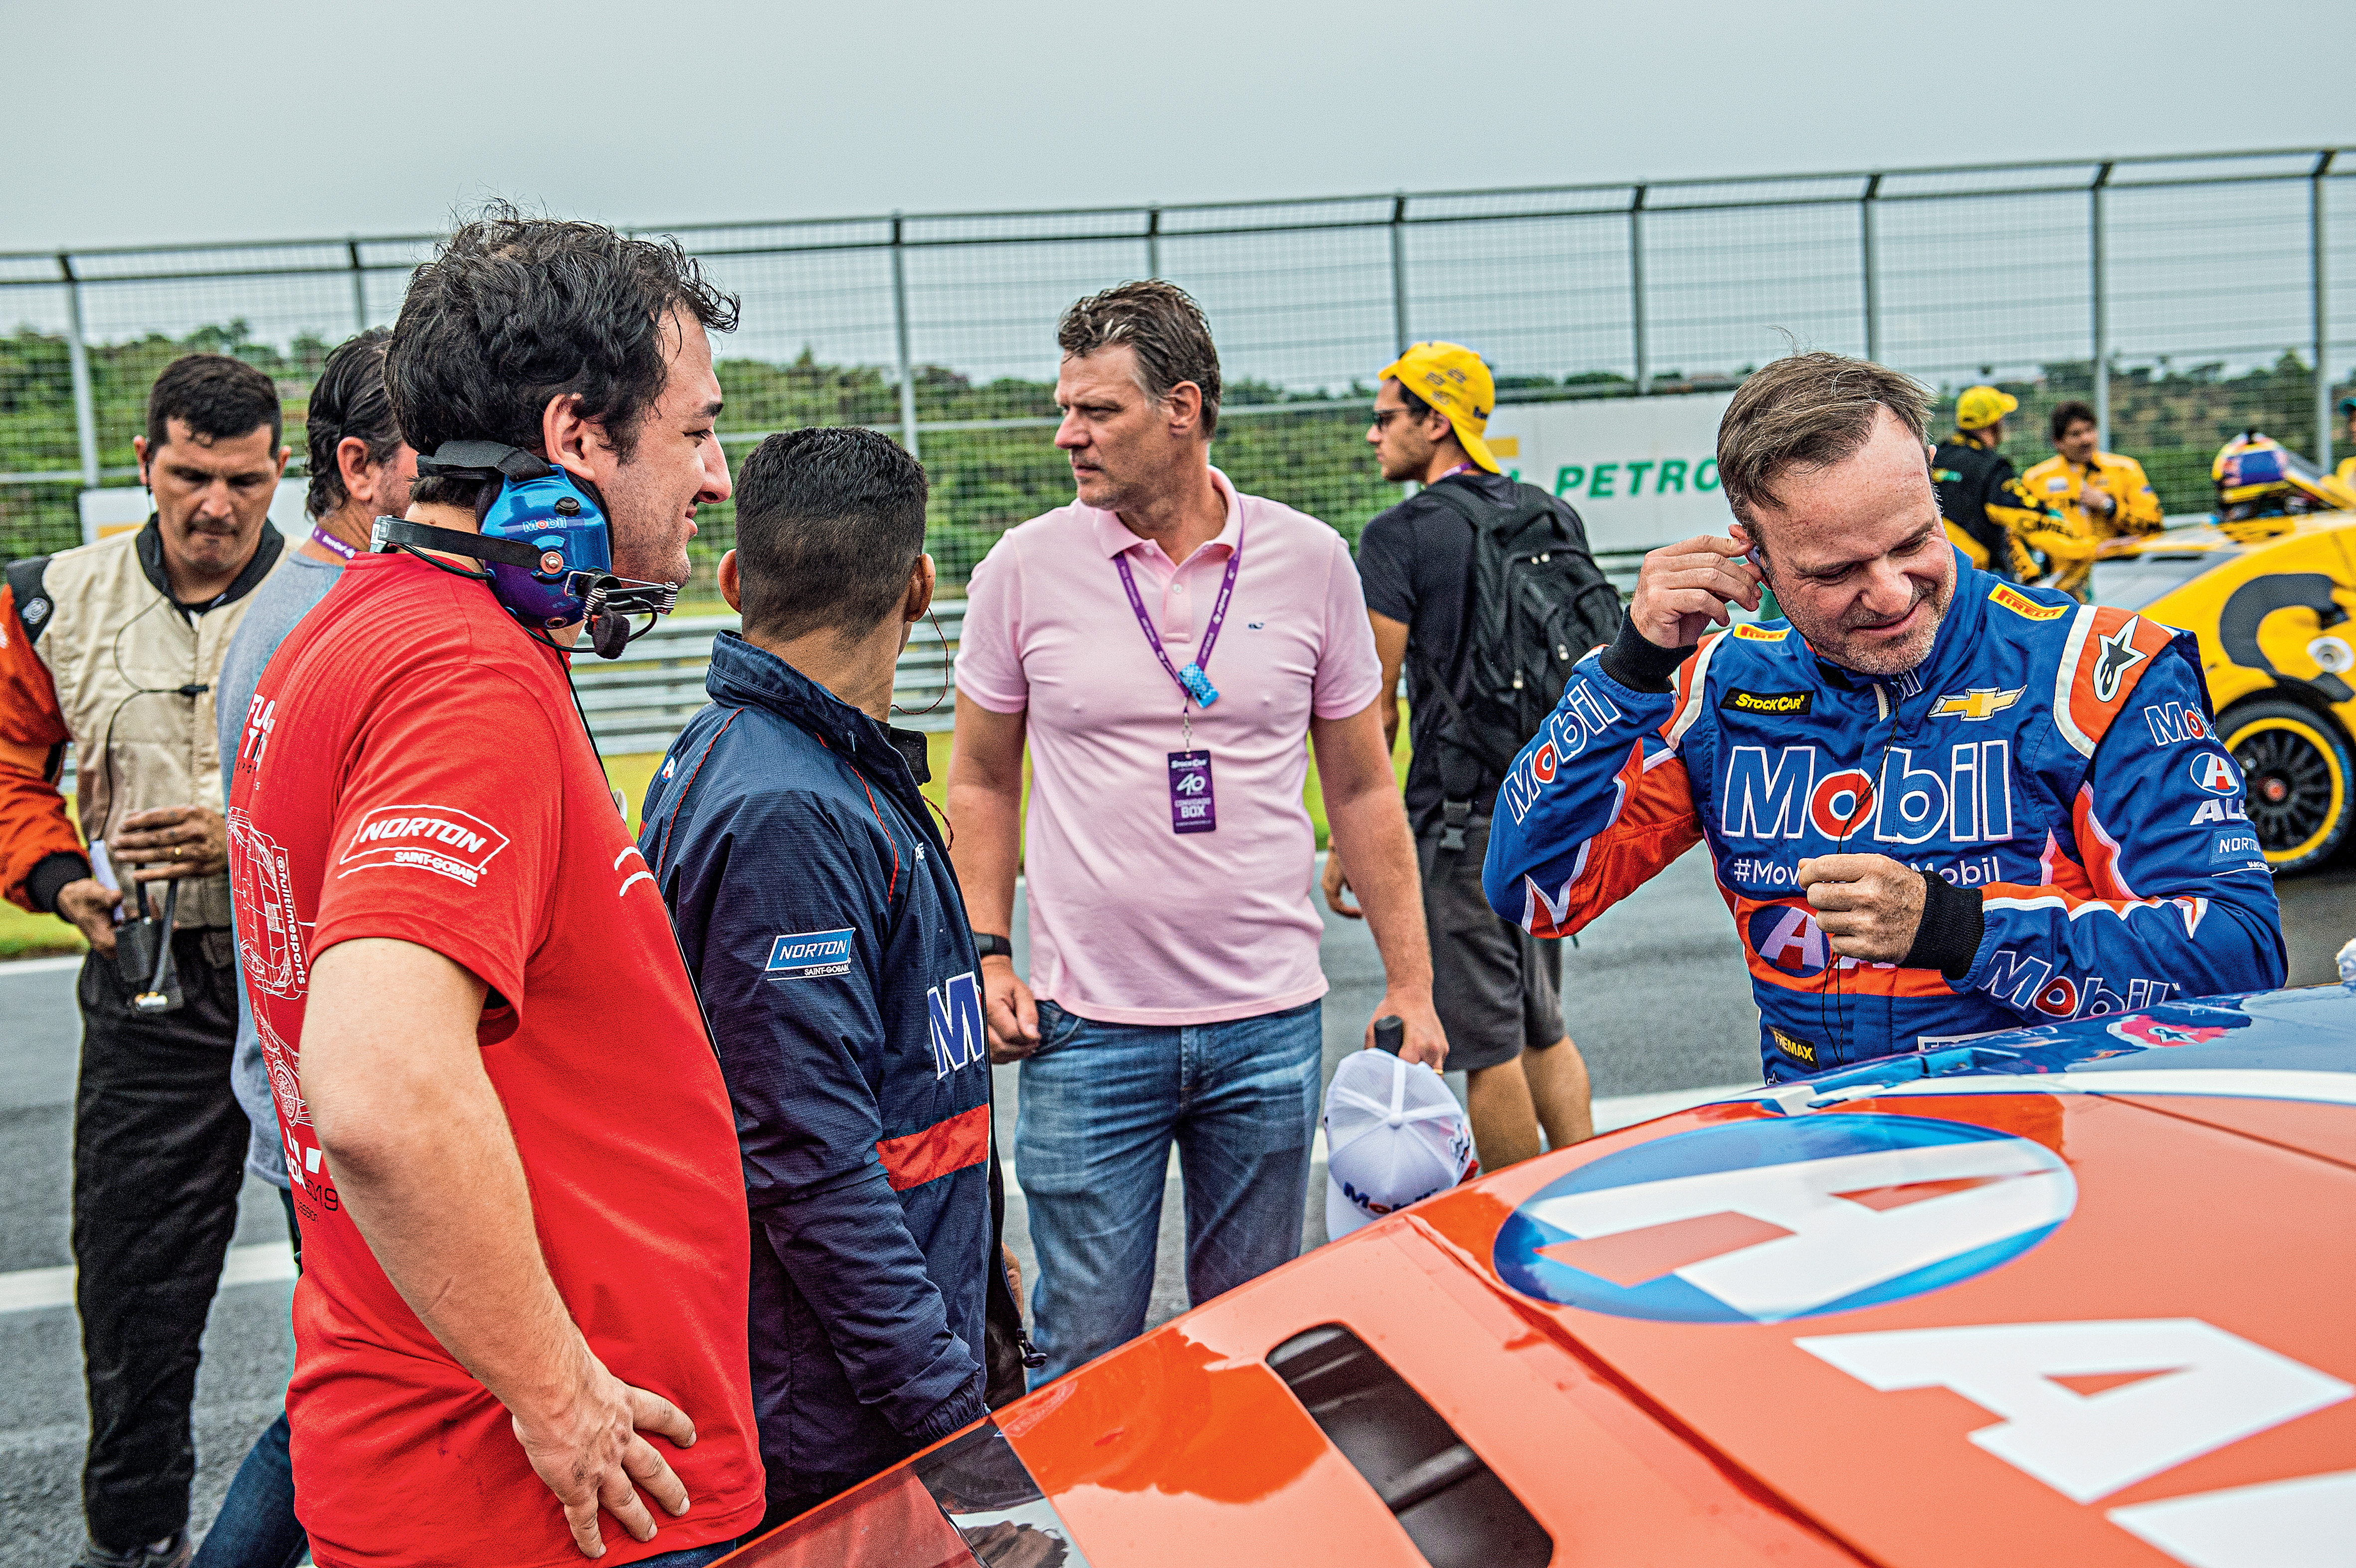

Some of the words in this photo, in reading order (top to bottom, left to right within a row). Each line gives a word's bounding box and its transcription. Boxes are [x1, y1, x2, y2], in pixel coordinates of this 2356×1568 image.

[522, 517, 567, 533] Mobil
[1504, 678, 1621, 826] Mobil
[1722, 740, 2013, 844] Mobil
[1181, 805, 1206, 818] BOX
[359, 817, 487, 853] NORTON
[394, 851, 478, 883] SAINT-GOBAIN
[275, 856, 306, 984] @fulltimesports
[779, 940, 847, 960] NORTON
[1977, 951, 2169, 1022] Mobil
[1773, 1031, 1814, 1061] FREMAX
